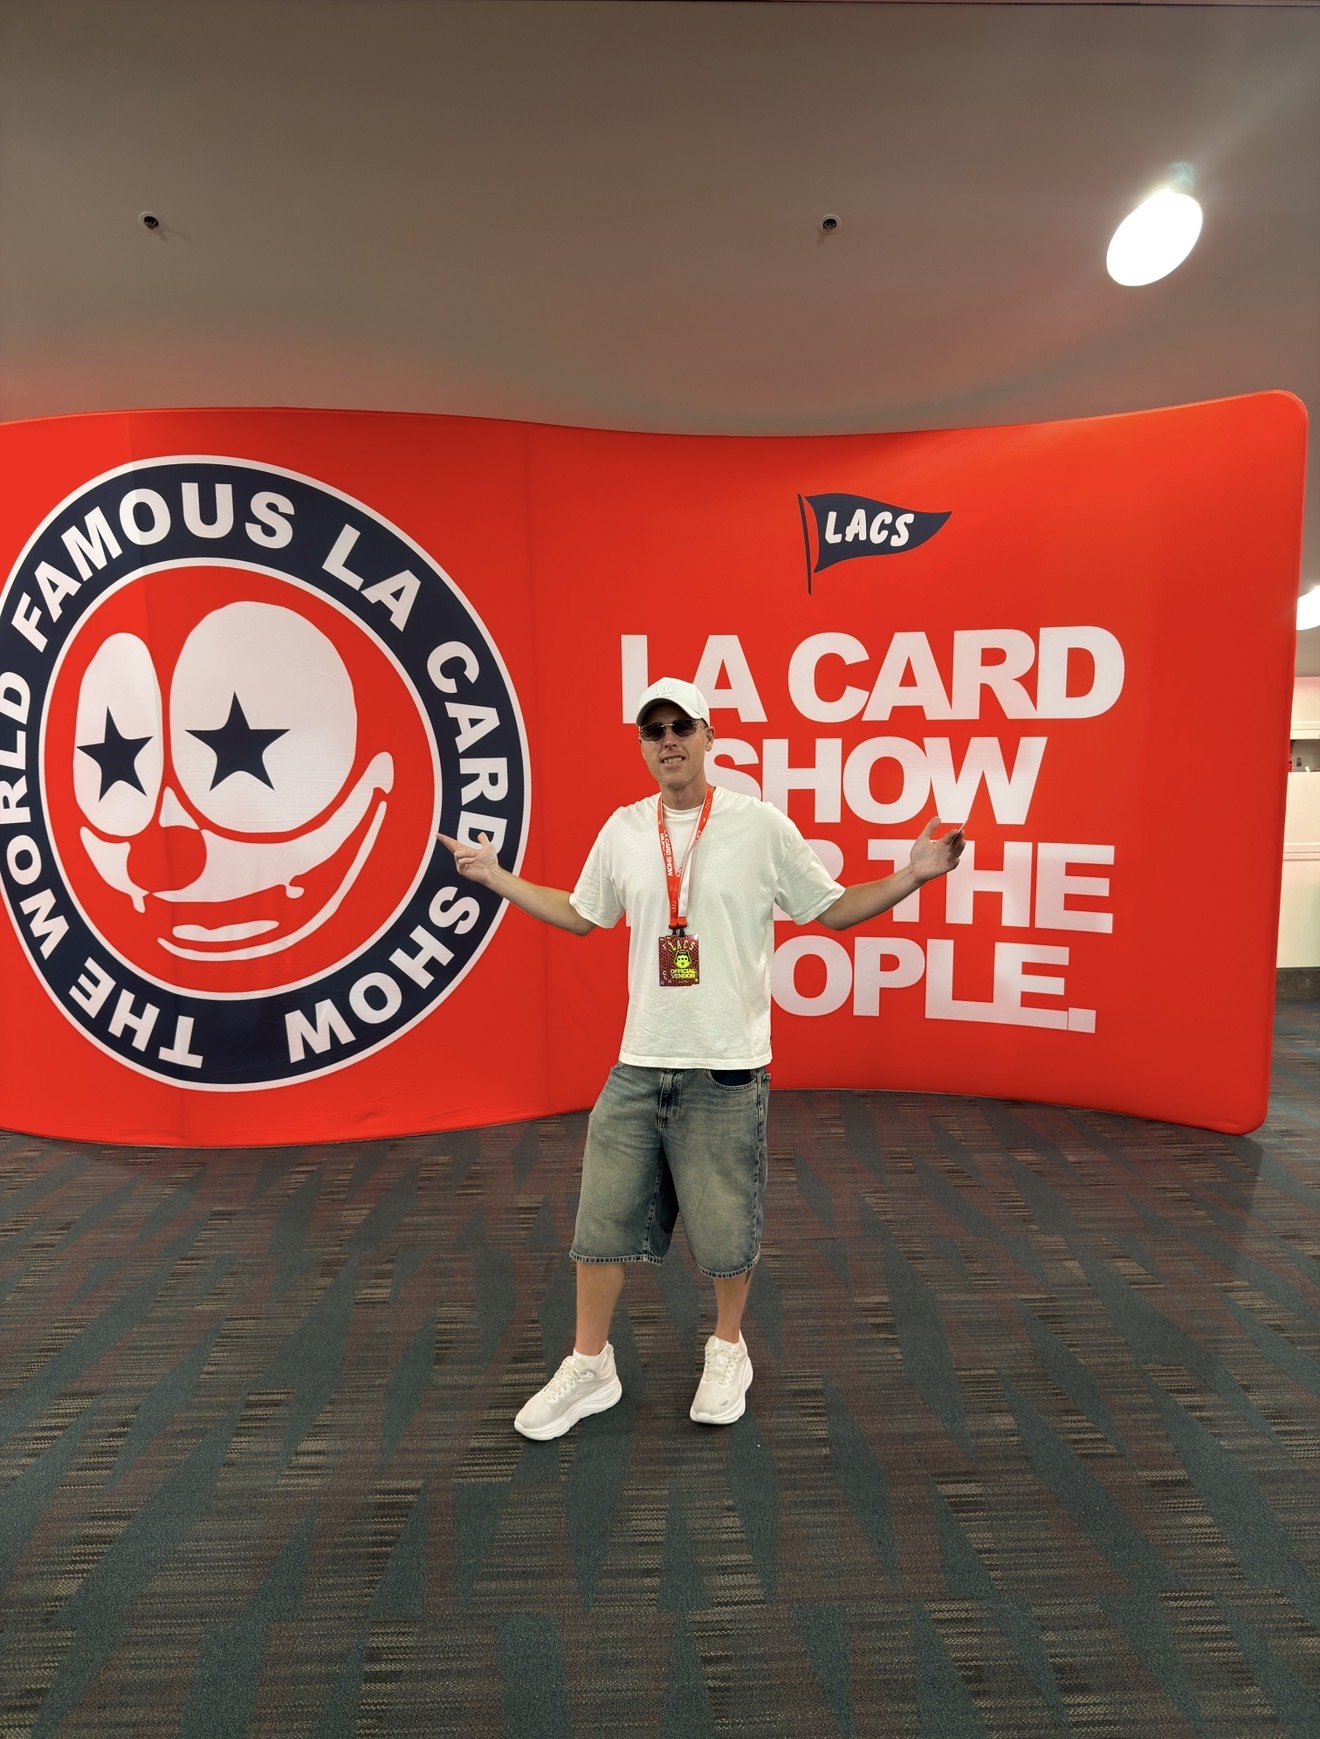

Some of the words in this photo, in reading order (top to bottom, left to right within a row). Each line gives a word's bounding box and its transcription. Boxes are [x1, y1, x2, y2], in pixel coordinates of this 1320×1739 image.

[11, 482, 296, 653] FAMOUS
[321, 523, 422, 632] LA
[824, 508, 915, 548] LACS
[787, 625, 1126, 724] CARD
[426, 640, 509, 855] CARD
[0, 671, 70, 960] WORLD
[664, 837, 672, 856] CARD
[867, 838, 1115, 934] THE
[283, 885, 481, 1064] SHOW
[667, 939, 696, 952] LACS
[771, 934, 1097, 1035] OPLE.
[68, 956, 204, 1069] THE
